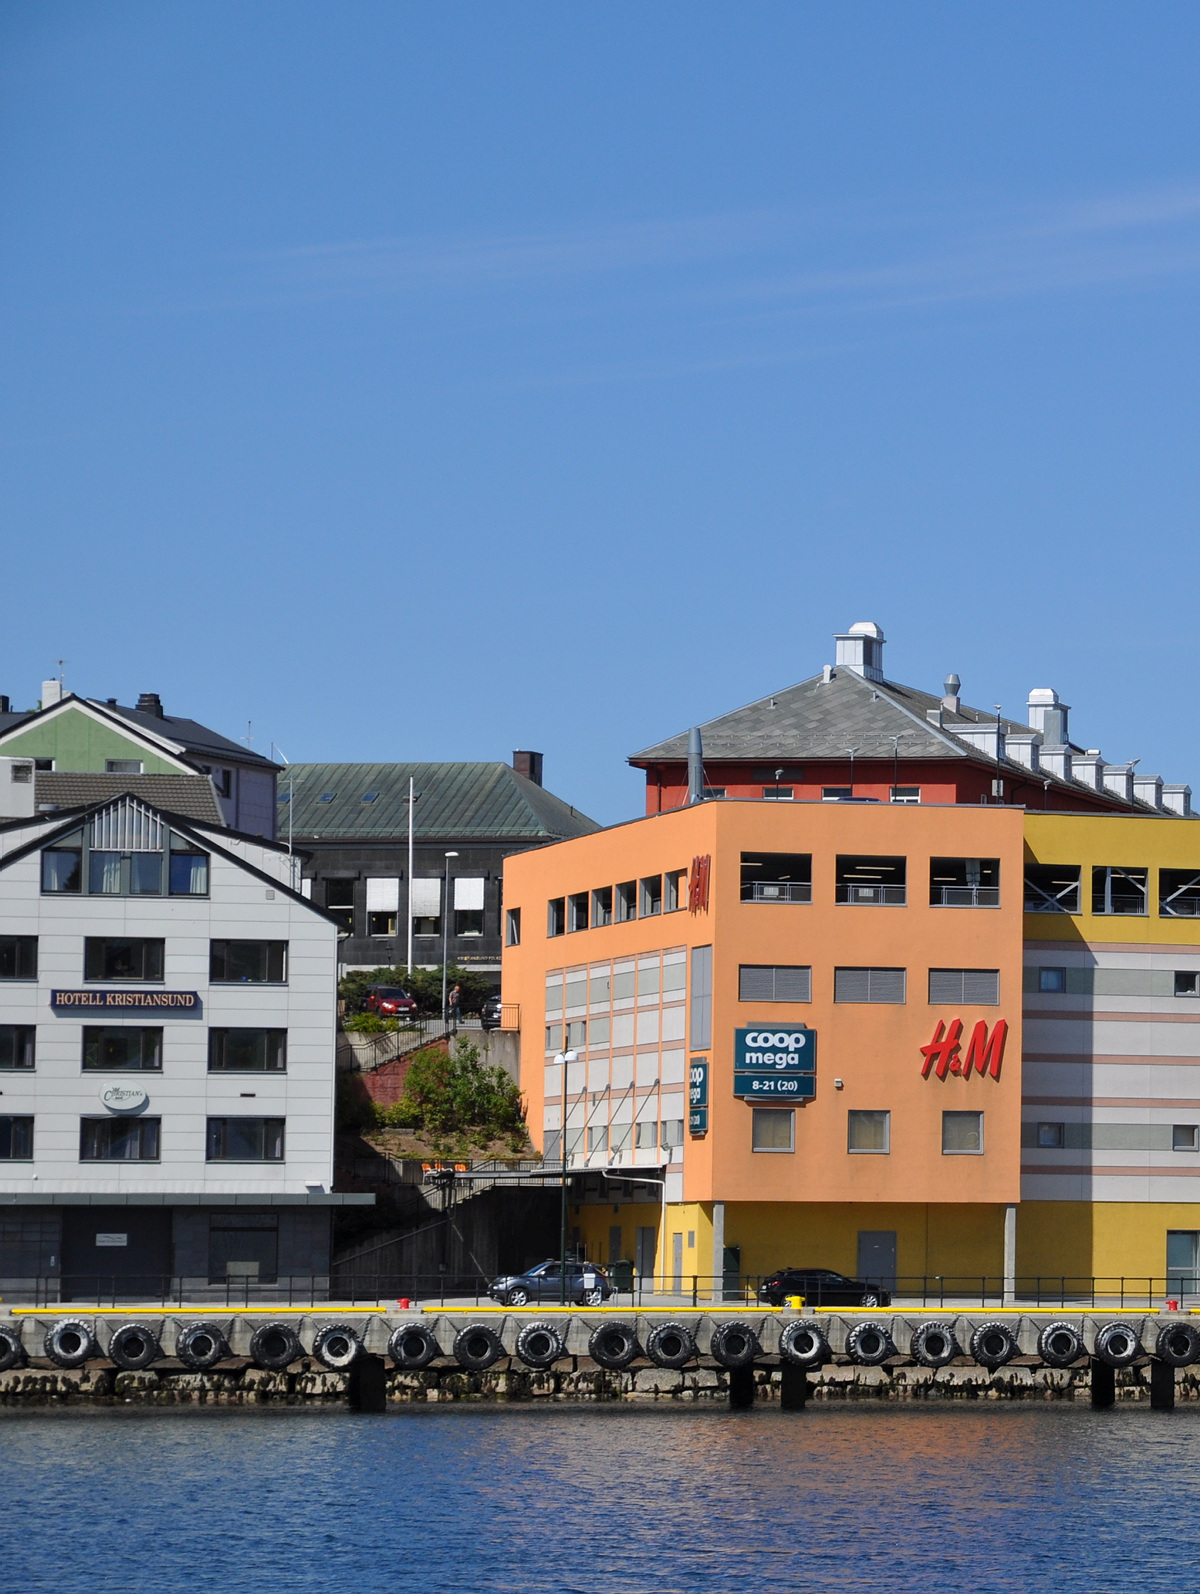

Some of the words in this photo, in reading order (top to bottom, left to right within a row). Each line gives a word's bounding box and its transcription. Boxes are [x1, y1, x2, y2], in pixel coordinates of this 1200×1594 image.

[55, 992, 103, 1006] HOTELL
[106, 993, 195, 1007] KRISTIANSUND
[745, 1032, 806, 1051] coop
[920, 1018, 1007, 1079] H&M
[745, 1052, 799, 1069] mega
[752, 1080, 775, 1091] 8-21
[777, 1080, 798, 1092] (20)
